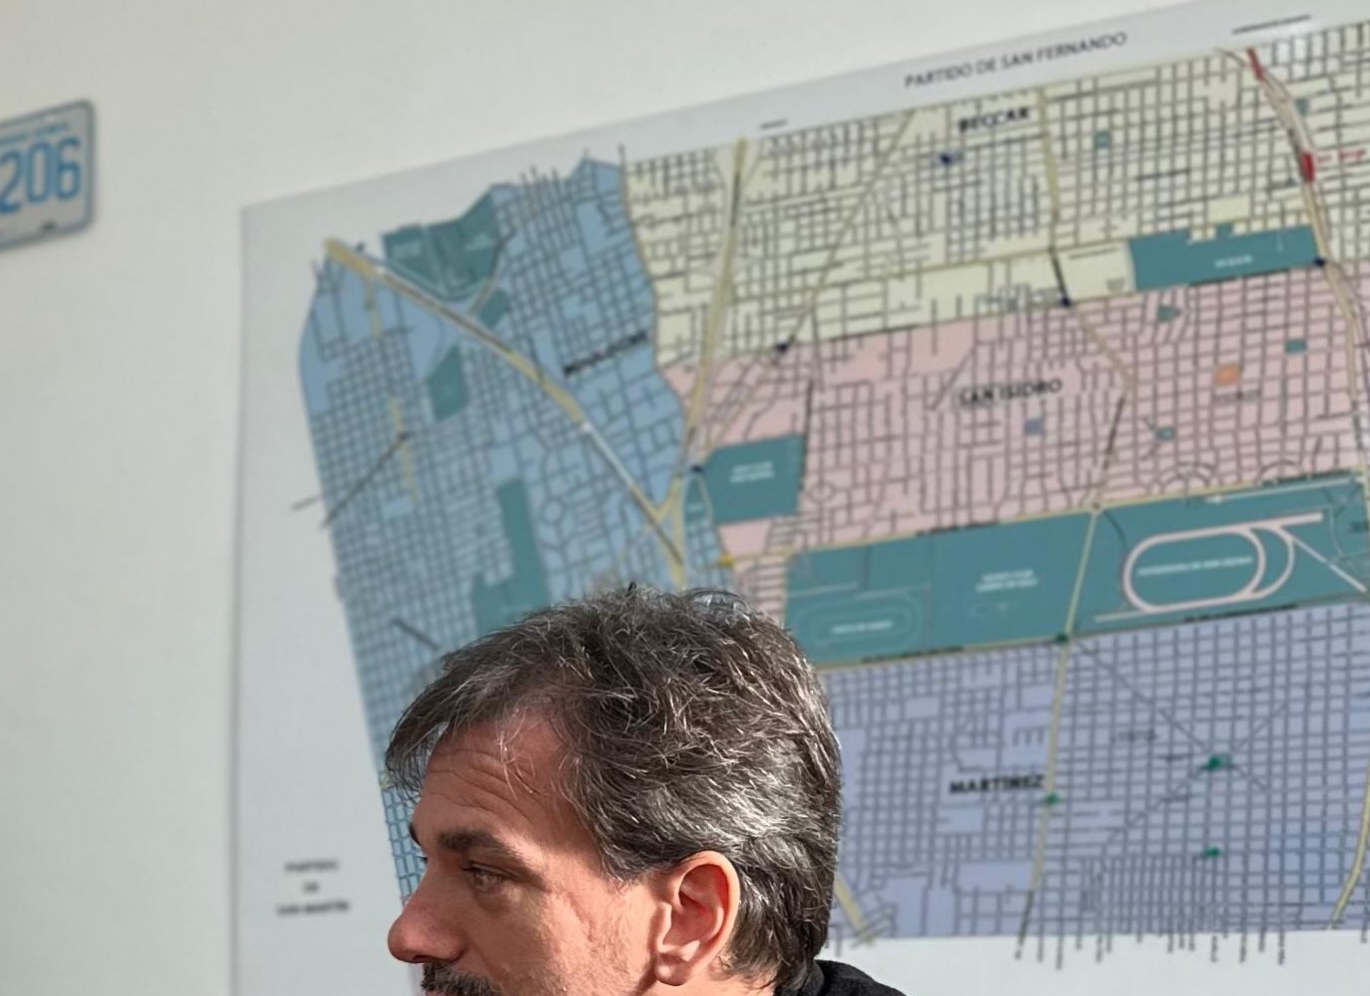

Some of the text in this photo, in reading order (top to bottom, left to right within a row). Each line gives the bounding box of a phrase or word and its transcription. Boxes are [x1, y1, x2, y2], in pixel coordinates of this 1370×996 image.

[905, 32, 1127, 88] PARTIDO DE SAN FERNANDO
